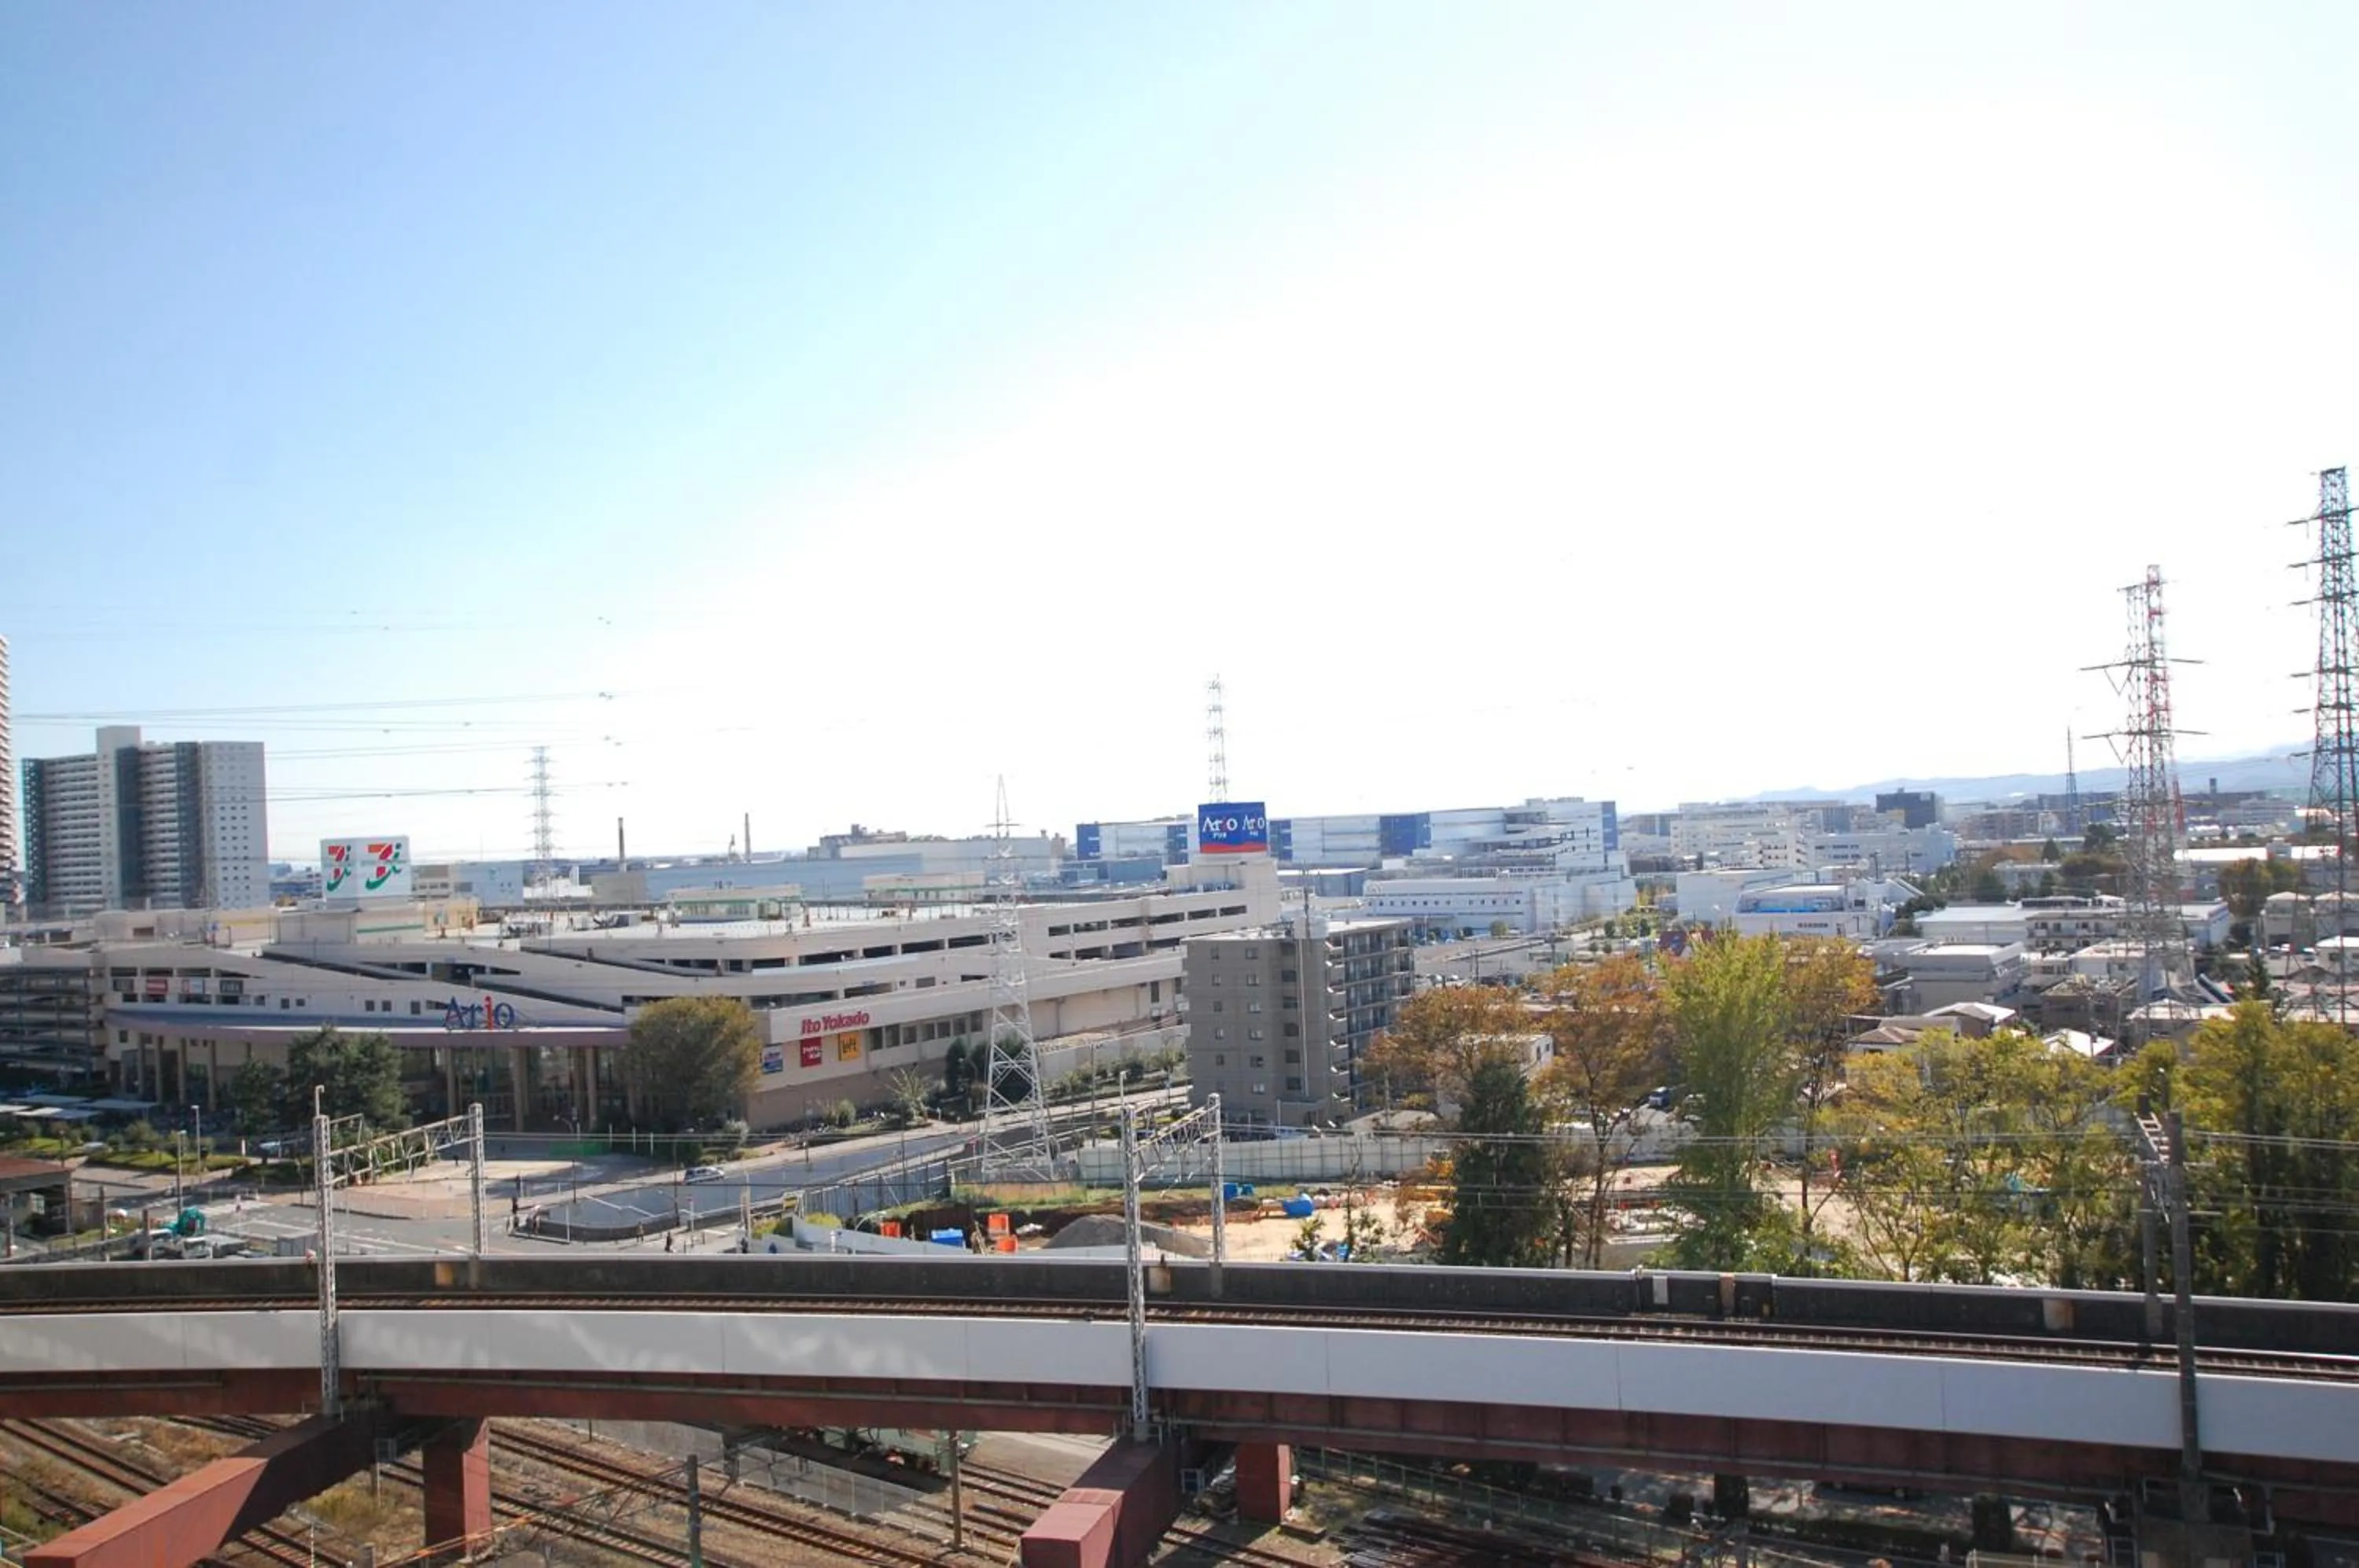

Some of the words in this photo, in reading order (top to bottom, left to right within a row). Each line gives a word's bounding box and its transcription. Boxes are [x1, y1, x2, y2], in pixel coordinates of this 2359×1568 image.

[443, 996, 515, 1030] Ario
[801, 1018, 822, 1034] Ito
[822, 1010, 870, 1032] Yokado
